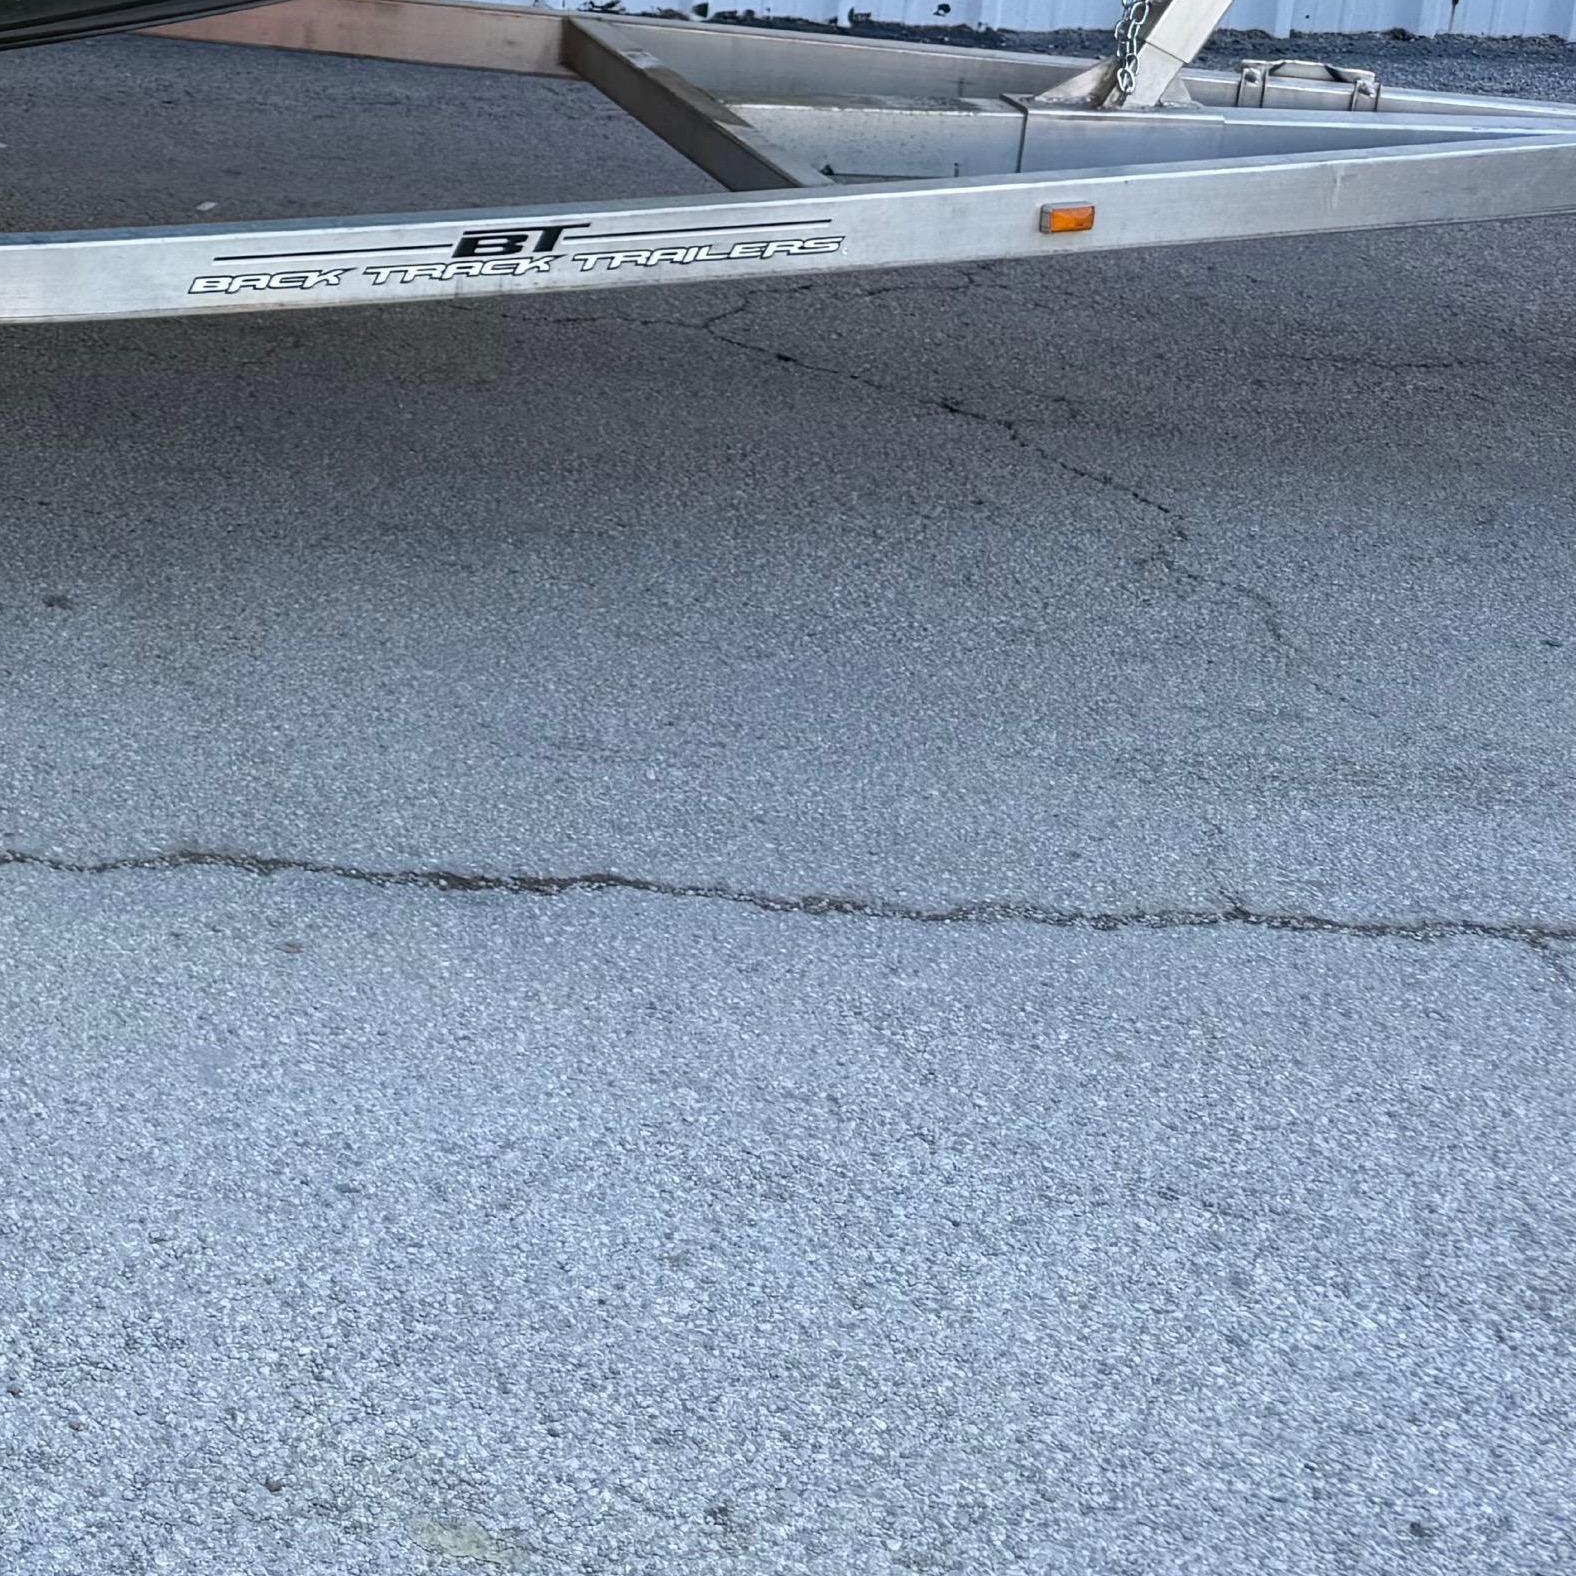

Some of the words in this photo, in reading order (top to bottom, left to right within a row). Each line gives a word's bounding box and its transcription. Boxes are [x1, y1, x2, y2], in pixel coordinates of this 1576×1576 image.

[188, 266, 357, 294] BACK
[362, 255, 558, 285] TRACK
[572, 235, 845, 272] TRAILERS
[452, 223, 591, 259] BT
